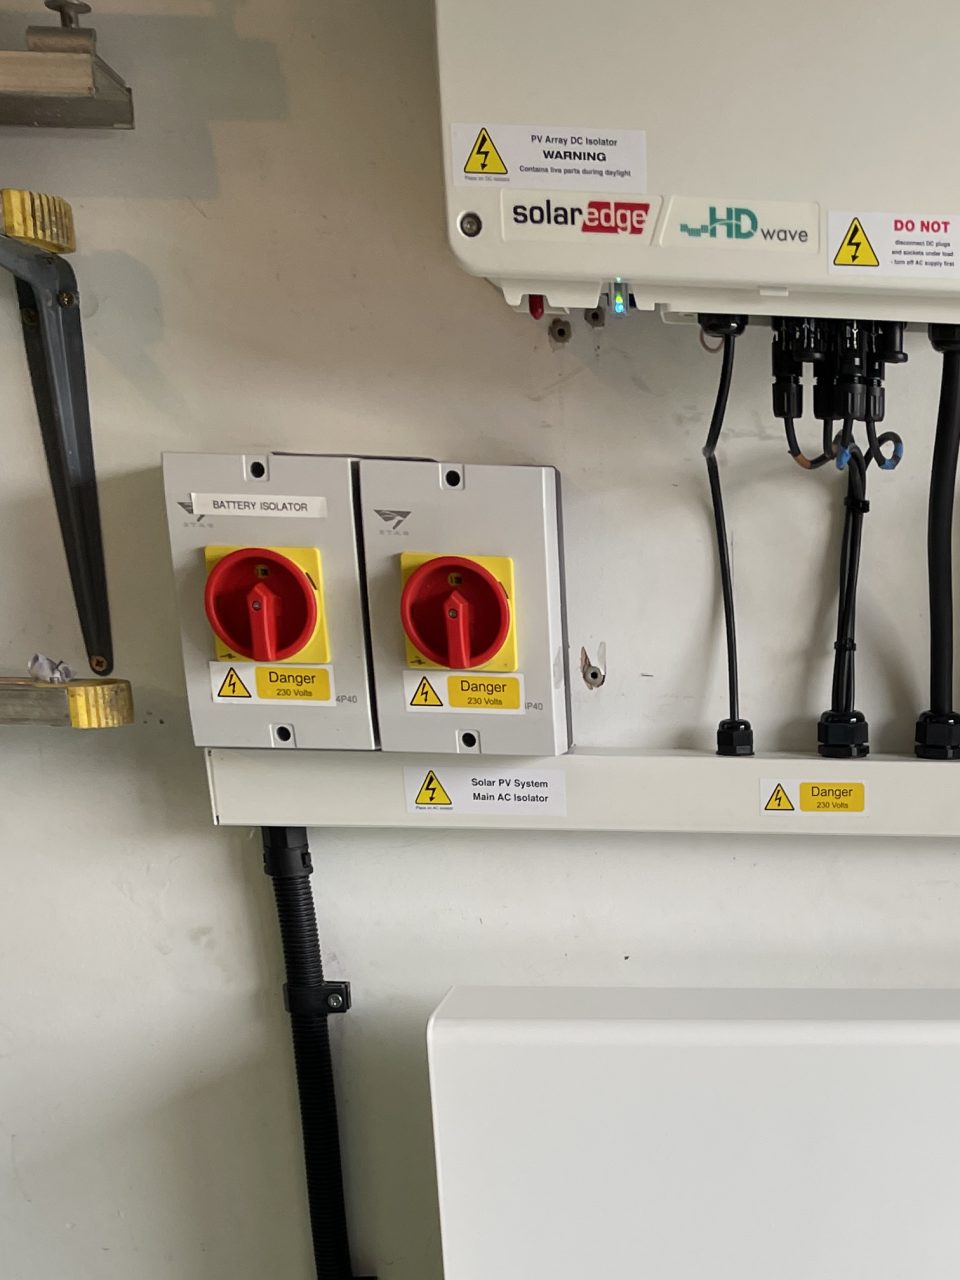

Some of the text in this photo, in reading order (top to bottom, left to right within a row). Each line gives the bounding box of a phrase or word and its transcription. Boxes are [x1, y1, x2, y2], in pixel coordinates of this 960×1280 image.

[530, 134, 618, 146] PV Array DC Isolator
[543, 150, 607, 162] WARNING
[519, 164, 632, 178] Contains live parts during daylight
[708, 206, 808, 243] HD wave
[894, 219, 950, 234] DO NOT
[212, 500, 308, 512] BATTERY ISOLATOR
[268, 671, 317, 687] Danger
[276, 688, 313, 697] 230 Volts
[460, 680, 508, 696] Danger
[467, 696, 503, 706] 230 Volts
[471, 778, 549, 790] Solar PV System
[472, 792, 549, 802] Main AC Isolator
[811, 786, 854, 800] Danger
[816, 801, 830, 809] 230
